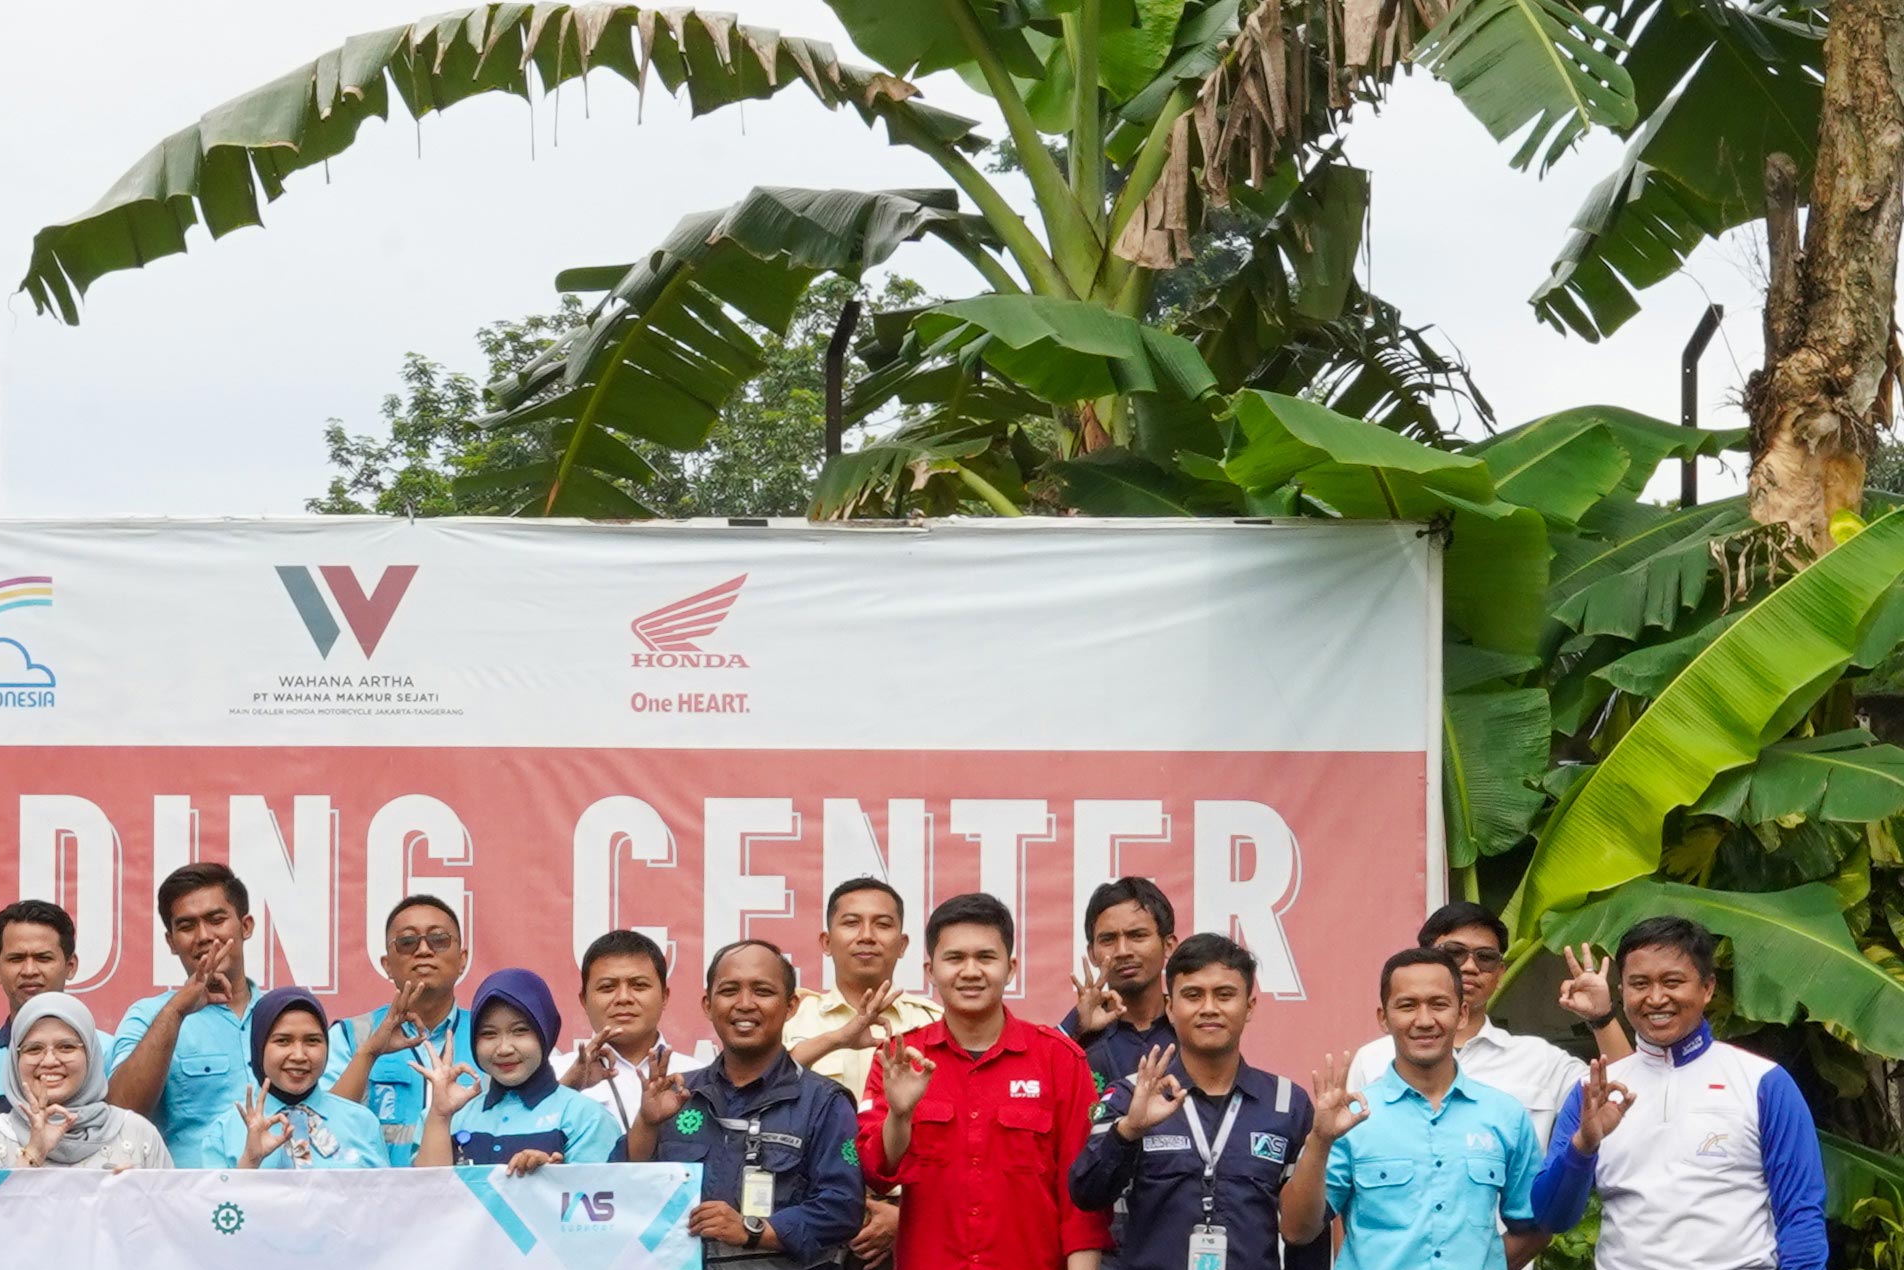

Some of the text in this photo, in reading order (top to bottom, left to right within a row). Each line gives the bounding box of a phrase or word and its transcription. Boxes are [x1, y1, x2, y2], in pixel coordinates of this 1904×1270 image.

[631, 653, 750, 668] HONDA
[279, 675, 415, 688] WAHANA ARTHA
[253, 693, 439, 702] PT WAHANA MAKMUR SEJATI
[631, 692, 750, 713] One HEART.
[229, 708, 464, 716] MAIN DEALER HONDA MOTORCYCLE JAKARTA-TANGERANG
[573, 795, 1308, 1000] CENTER
[561, 1191, 615, 1222] IAS
